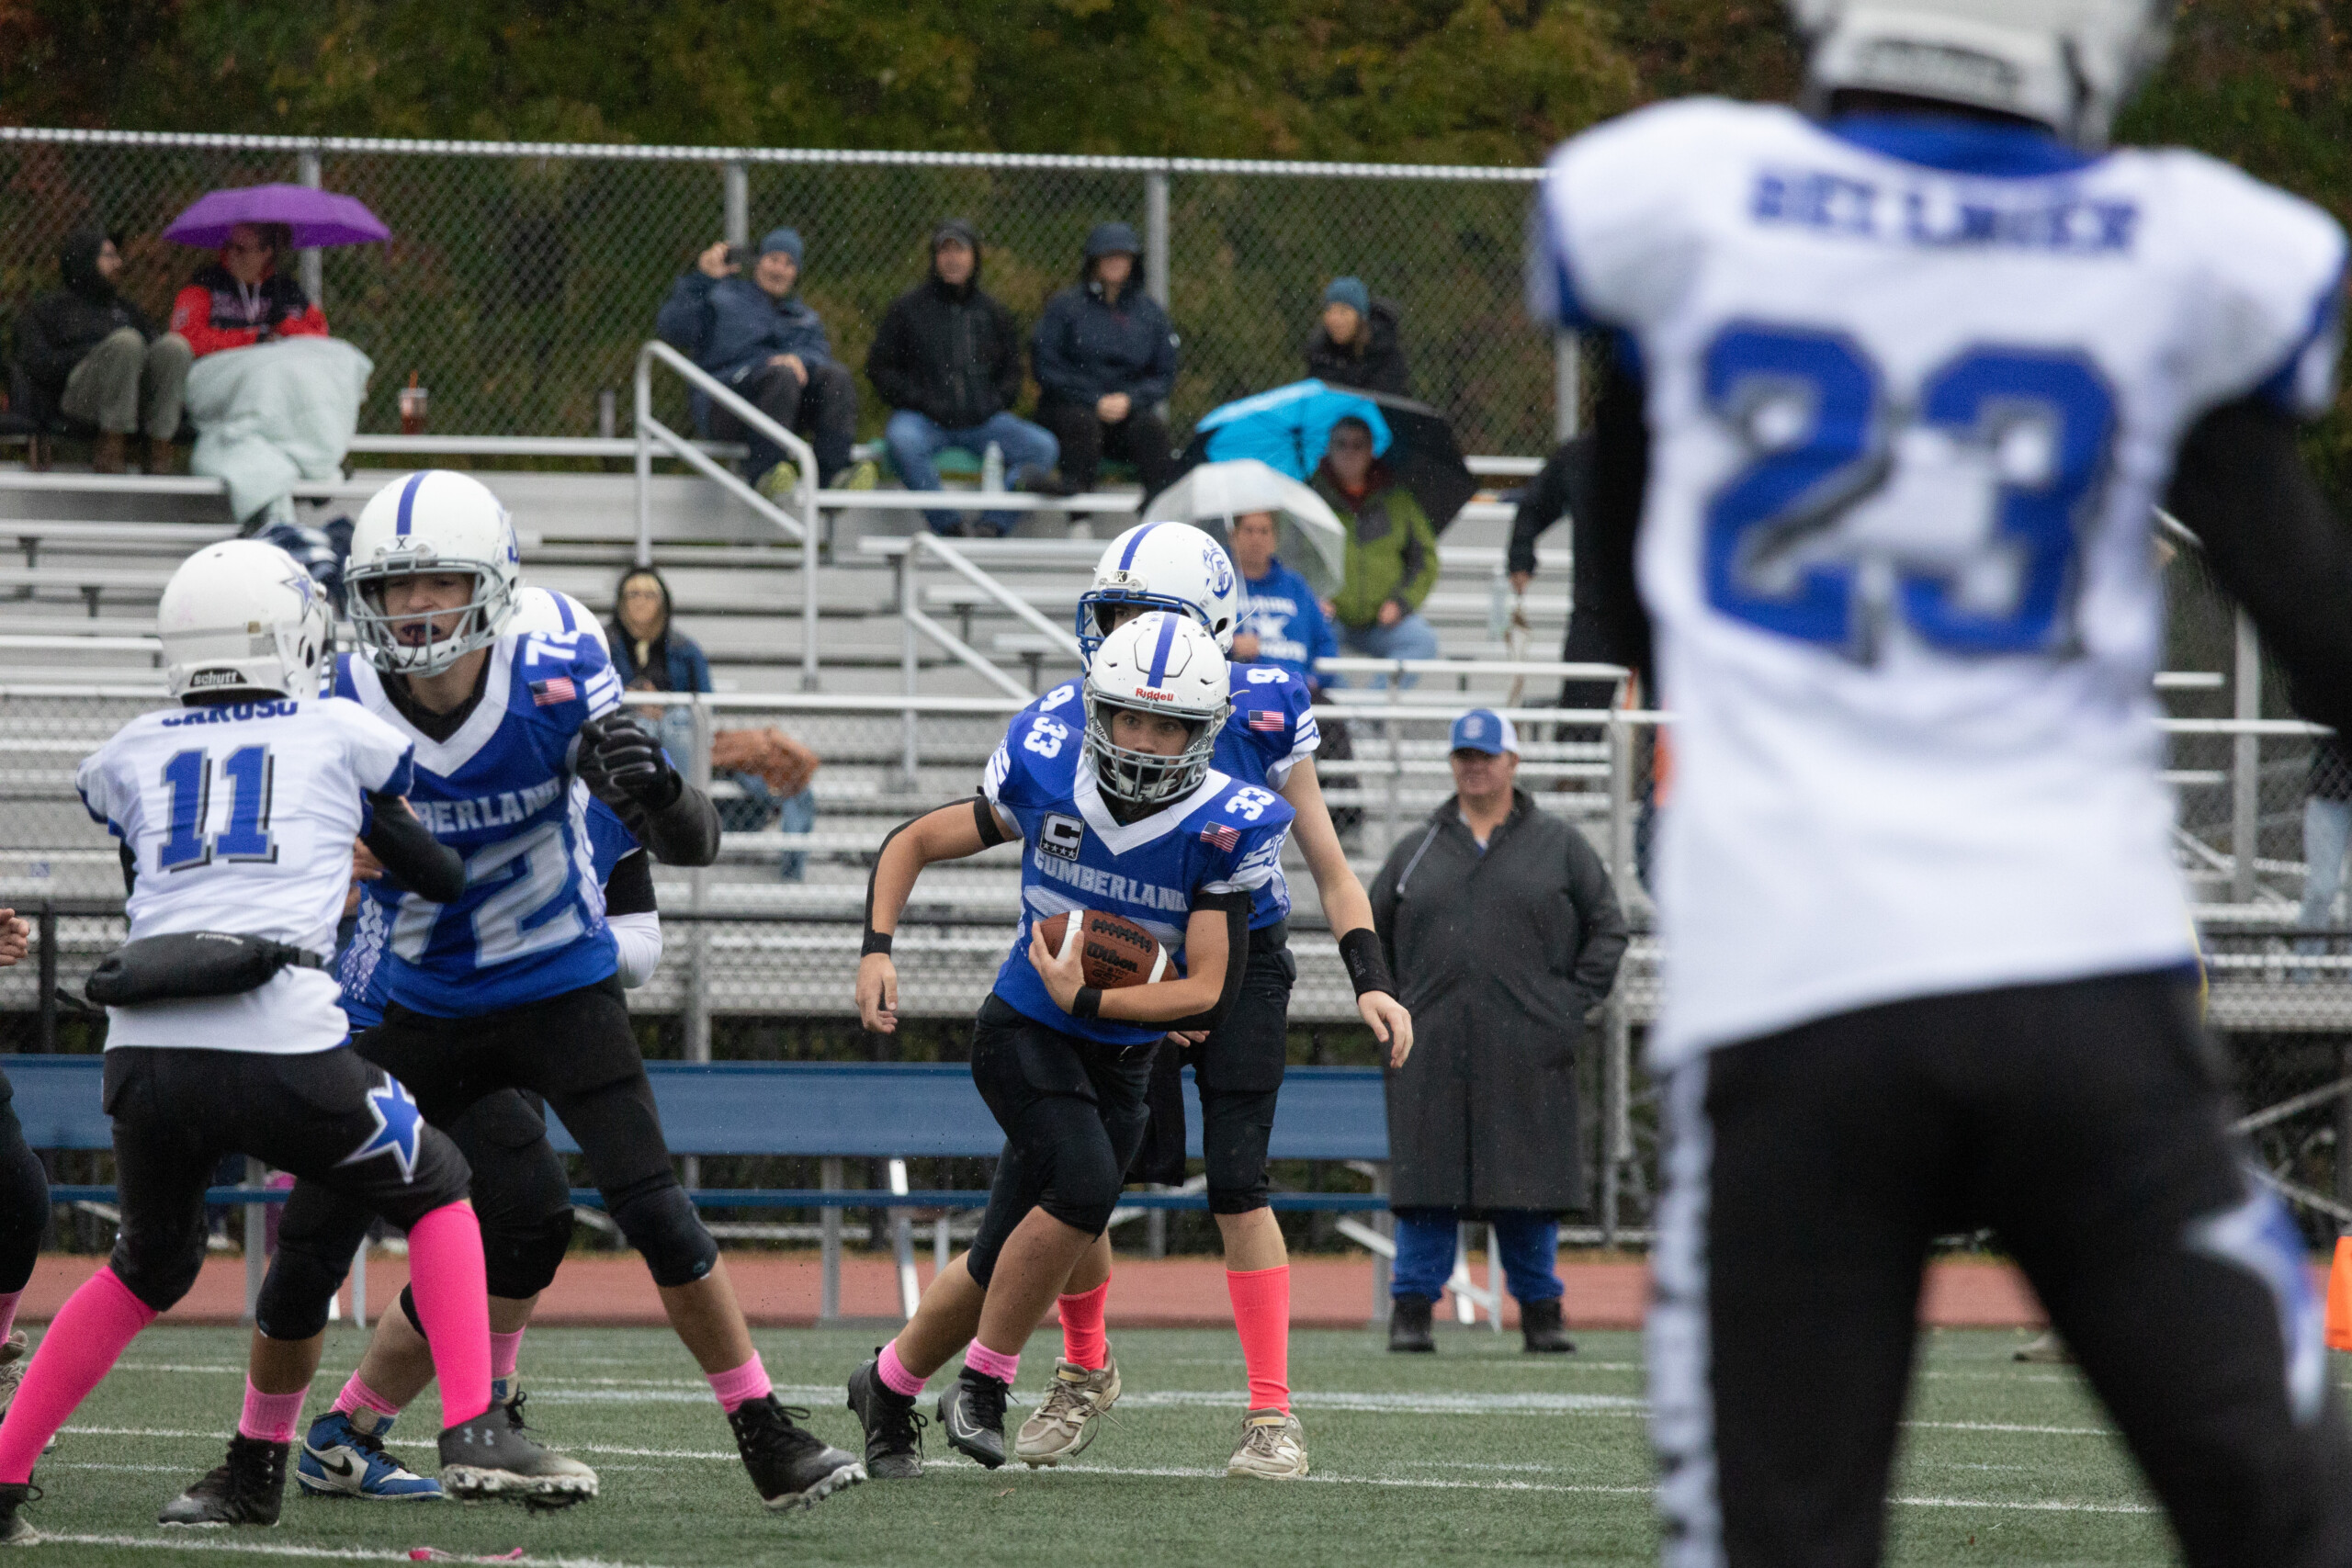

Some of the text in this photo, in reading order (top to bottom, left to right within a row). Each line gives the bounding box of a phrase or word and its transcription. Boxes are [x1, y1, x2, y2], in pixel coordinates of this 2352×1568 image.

[1698, 318, 2118, 660] 23
[193, 671, 238, 686] schutt
[1247, 668, 1289, 684] 9
[1039, 685, 1075, 712] 9
[1136, 688, 1174, 702] Riddell
[1023, 716, 1069, 759] 33
[157, 743, 278, 874] 11
[1225, 786, 1275, 821] 33
[1044, 815, 1081, 849] C
[1086, 941, 1138, 973] Wilson
